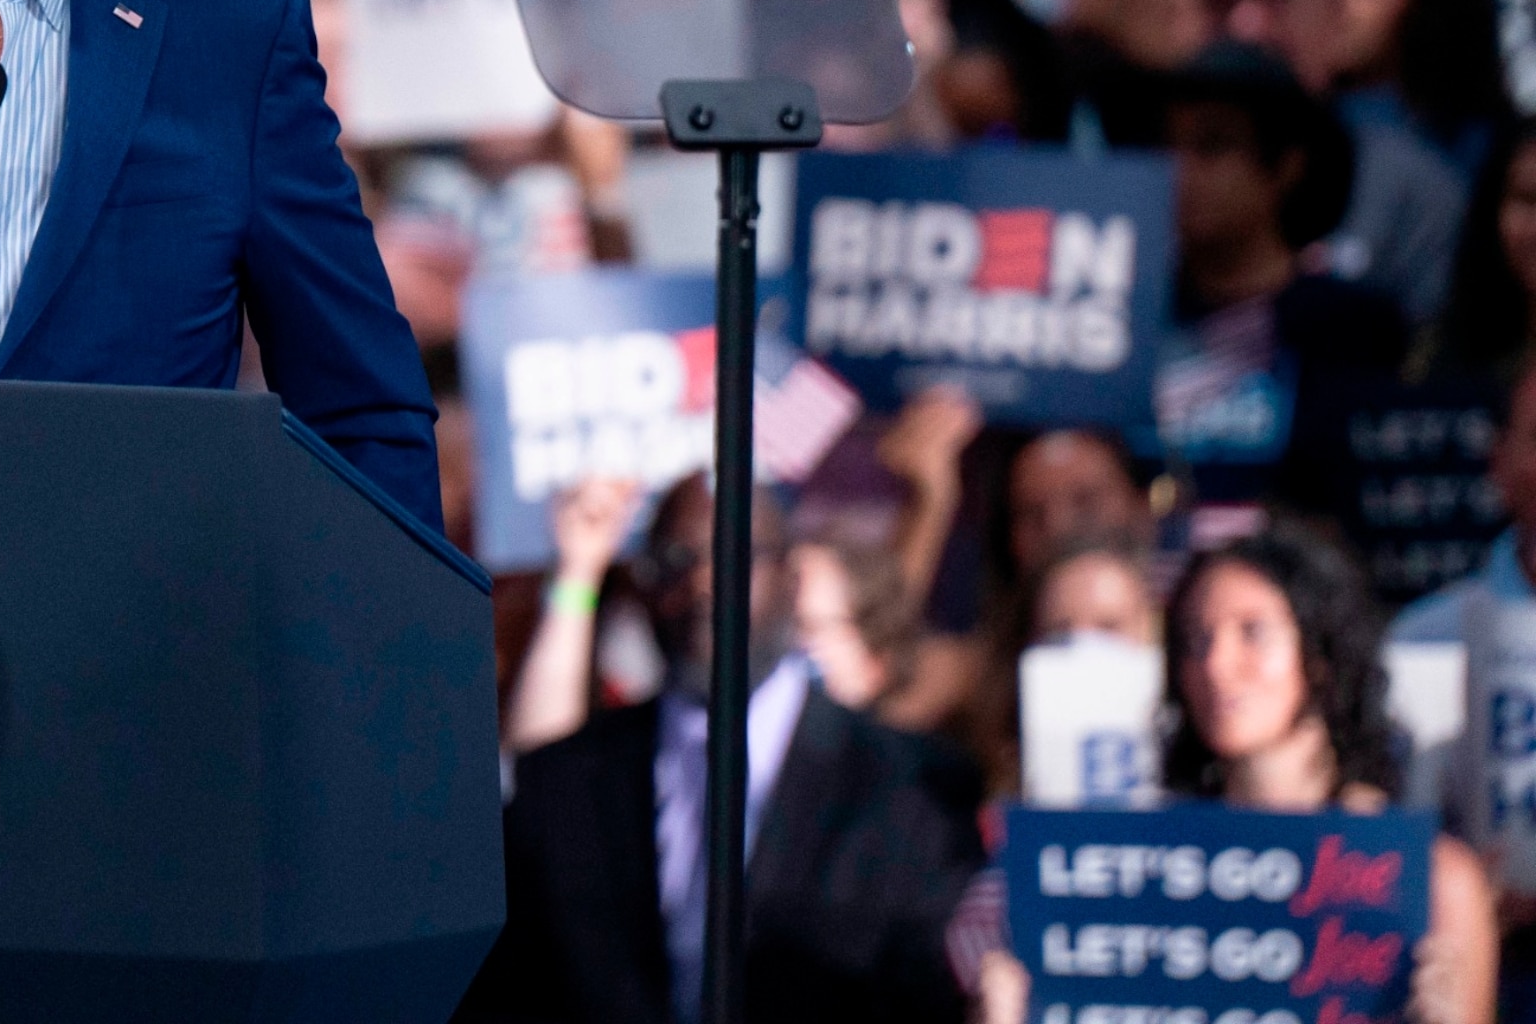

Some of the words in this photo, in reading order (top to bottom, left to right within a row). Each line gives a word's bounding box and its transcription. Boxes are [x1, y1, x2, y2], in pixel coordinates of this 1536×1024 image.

[810, 196, 1138, 298] BIDEN
[806, 274, 1133, 373] HARRIS
[1038, 843, 1208, 901] LET'S
[1208, 846, 1304, 903] GO
[1288, 833, 1405, 917] Joe
[1041, 921, 1209, 980] LET'S
[1209, 926, 1305, 983] GO
[1288, 916, 1405, 998] Joe
